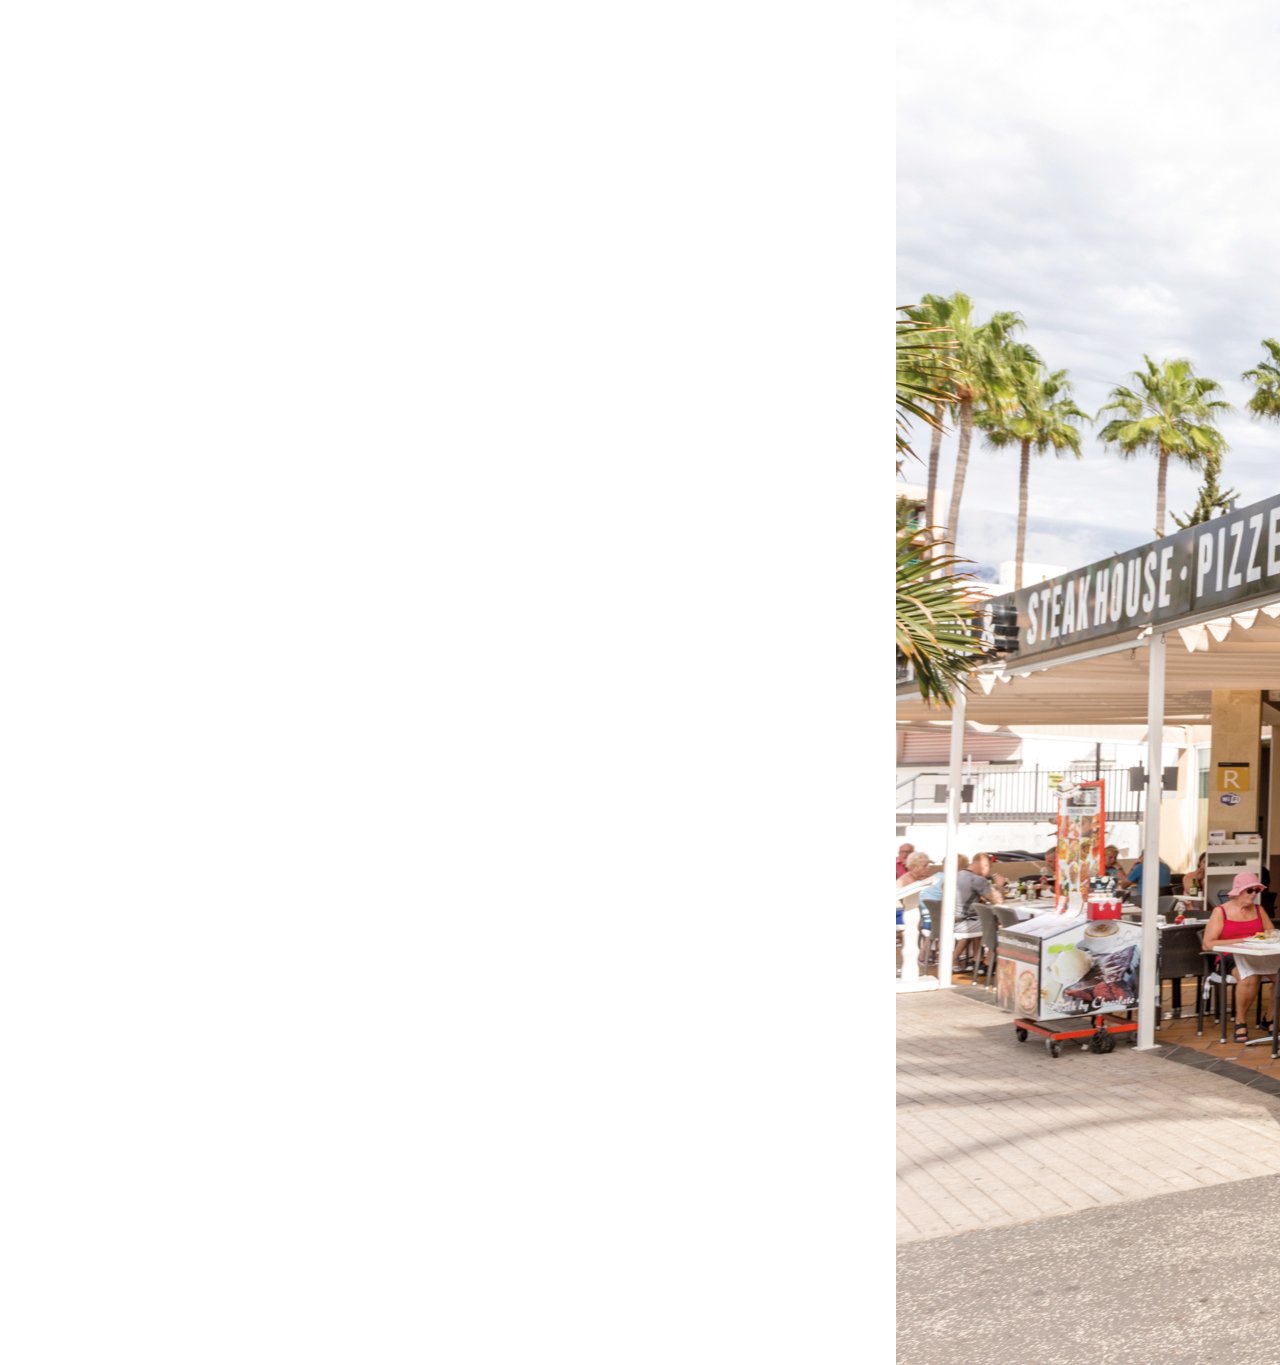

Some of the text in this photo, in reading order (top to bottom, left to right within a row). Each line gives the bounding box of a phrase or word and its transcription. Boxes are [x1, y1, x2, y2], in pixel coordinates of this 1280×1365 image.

[1026, 574, 1092, 646] STEAK
[1093, 545, 1175, 626] HOUSE
[1223, 770, 1240, 788] R
